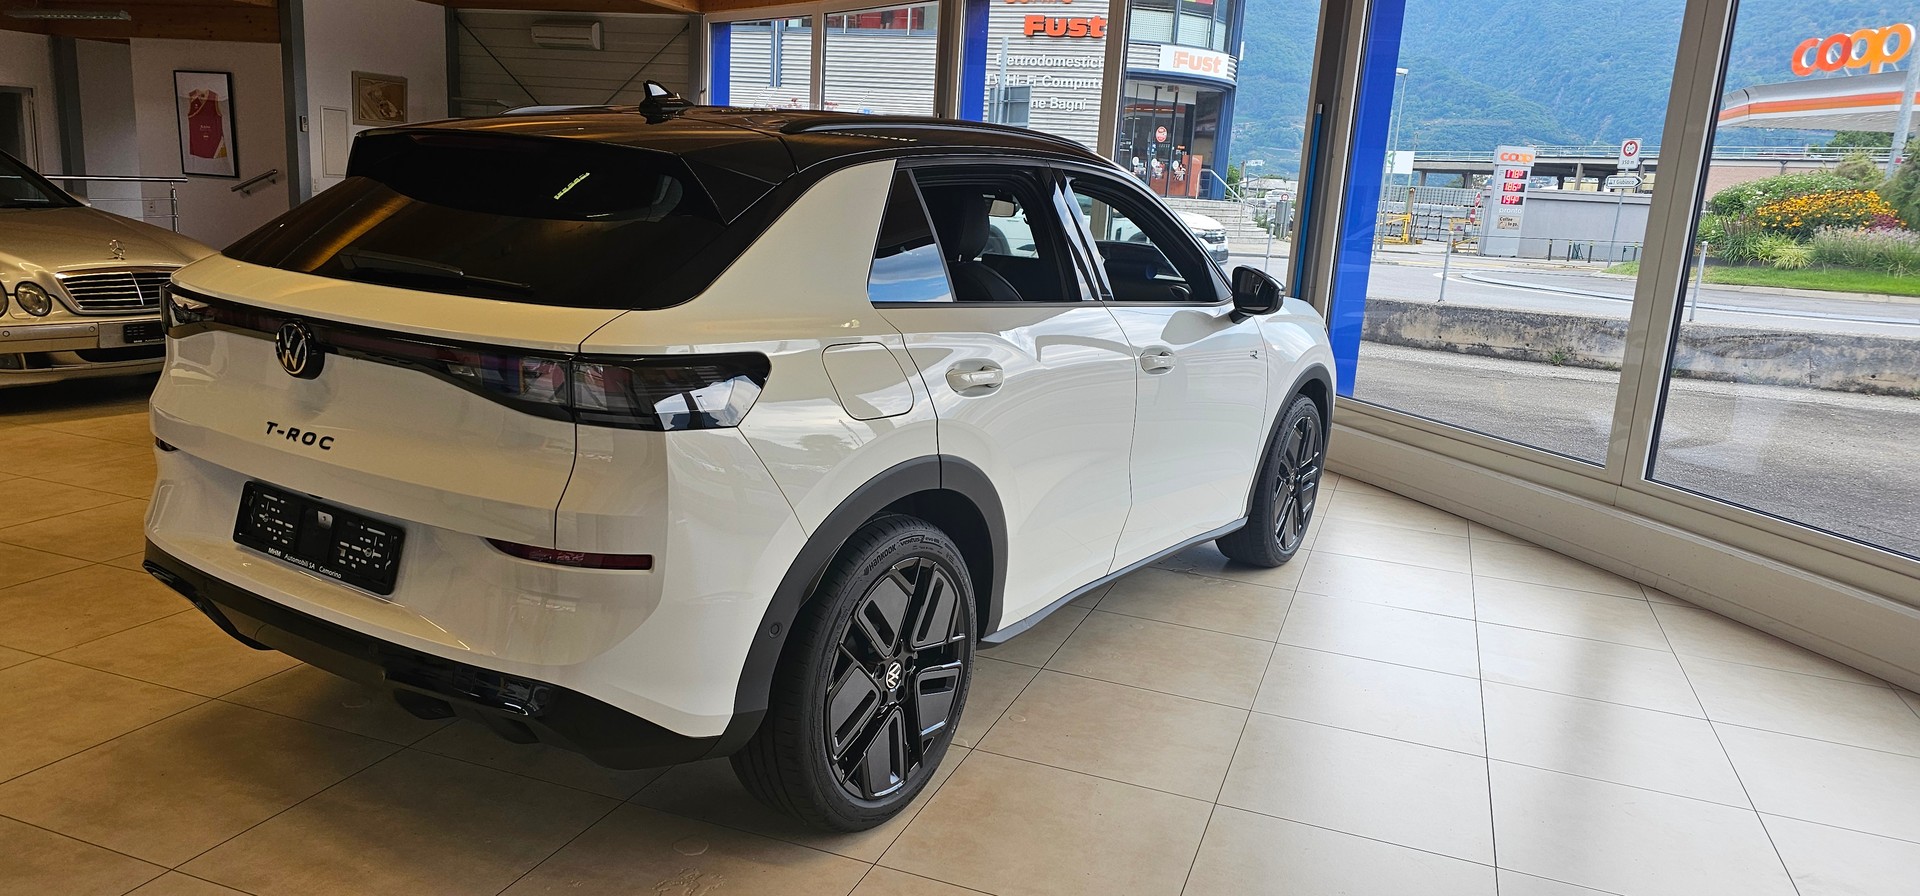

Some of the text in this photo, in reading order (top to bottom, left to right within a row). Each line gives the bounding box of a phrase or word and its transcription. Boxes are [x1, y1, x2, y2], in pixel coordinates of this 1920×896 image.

[1023, 14, 1107, 38] Fust
[996, 53, 1103, 68] Eettrodomestici
[1791, 23, 1914, 76] coop
[1173, 51, 1222, 74] Fust
[1050, 97, 1087, 111] Bagni
[1500, 152, 1533, 163] coop
[266, 421, 335, 450] T-ROC
[268, 547, 342, 579] MHM Automobili SA Camorino
